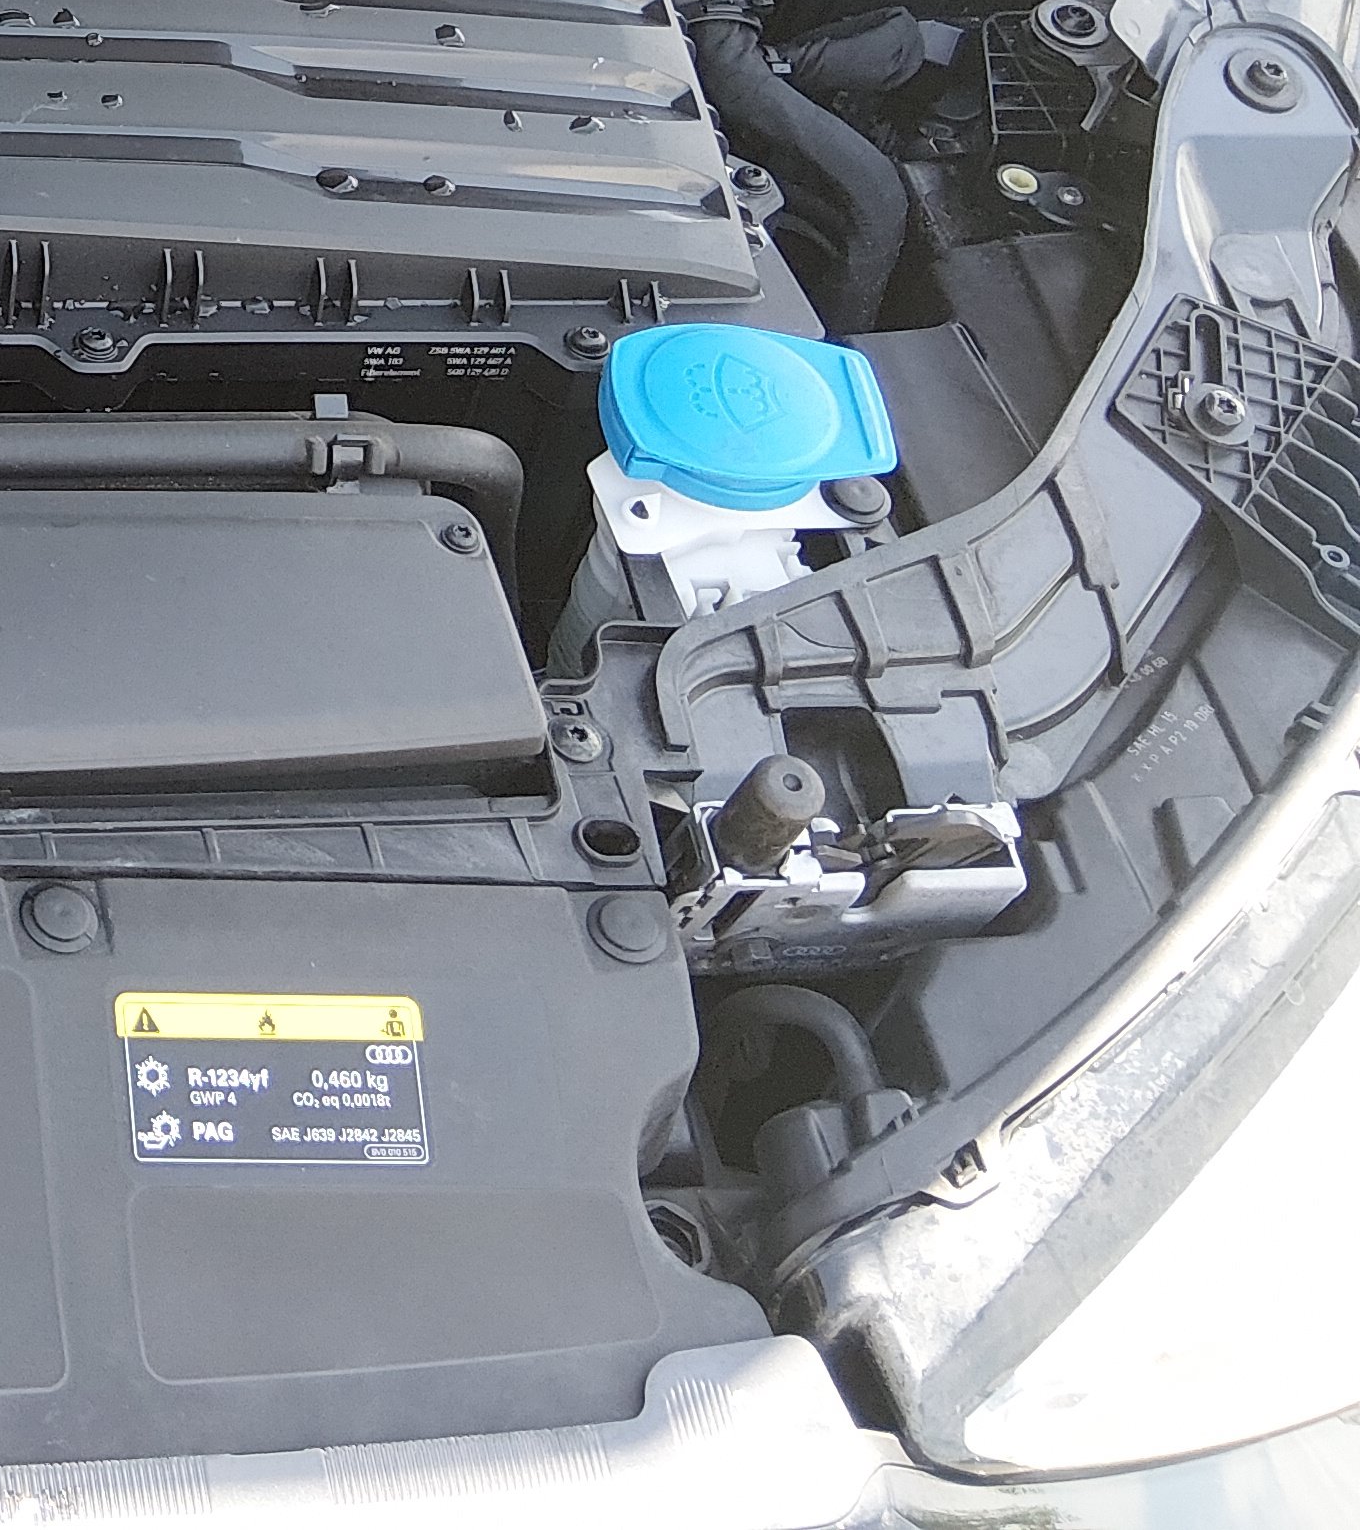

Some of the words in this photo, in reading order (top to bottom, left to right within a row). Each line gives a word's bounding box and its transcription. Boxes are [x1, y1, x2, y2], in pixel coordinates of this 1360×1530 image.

[1126, 735, 1152, 756] SAE
[186, 1067, 270, 1093] R-1234yf
[366, 1071, 389, 1094] kg
[189, 1090, 225, 1107] GWP
[226, 1091, 238, 1106] 4
[322, 1095, 340, 1111] eq
[191, 1121, 234, 1143] PAG
[271, 1126, 301, 1142] SAE
[302, 1127, 336, 1143] J639
[338, 1127, 379, 1143] J2842
[380, 1128, 422, 1143] J2845
